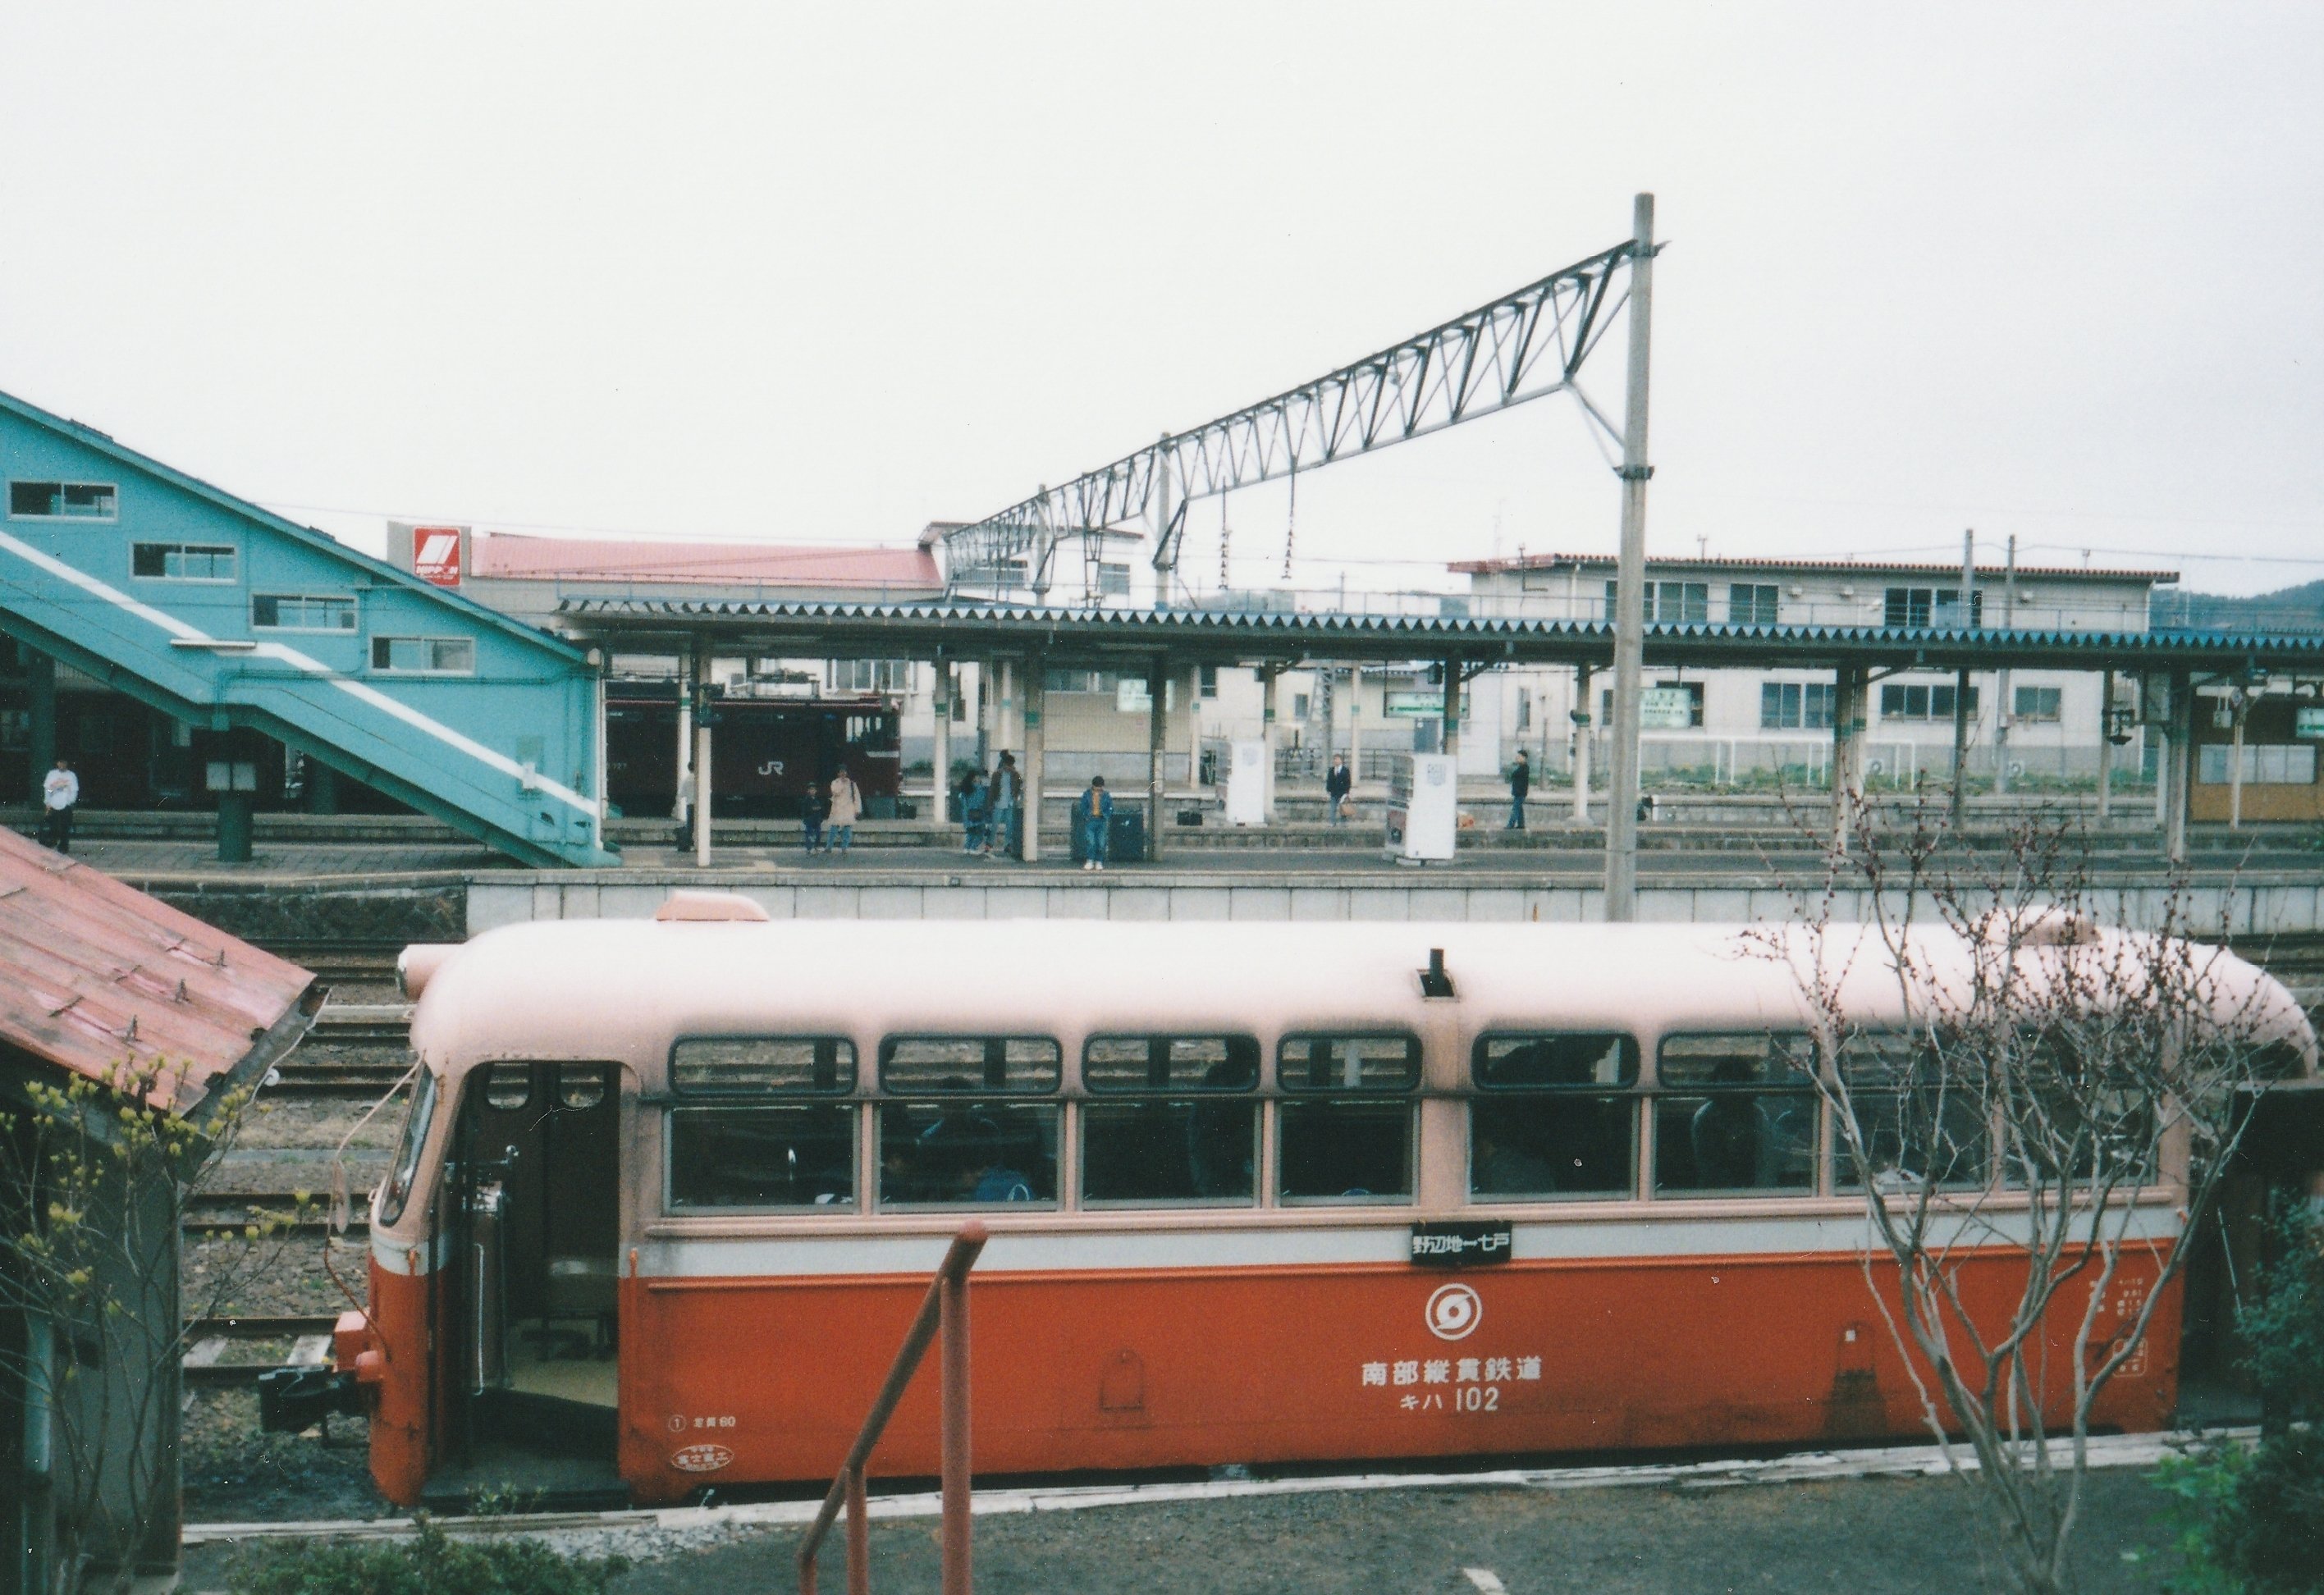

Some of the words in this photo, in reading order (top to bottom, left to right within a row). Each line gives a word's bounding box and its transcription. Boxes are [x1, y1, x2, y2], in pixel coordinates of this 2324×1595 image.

[757, 761, 785, 775] JR
[1399, 1393, 1443, 1410] キハ
[1456, 1387, 1499, 1411] 102
